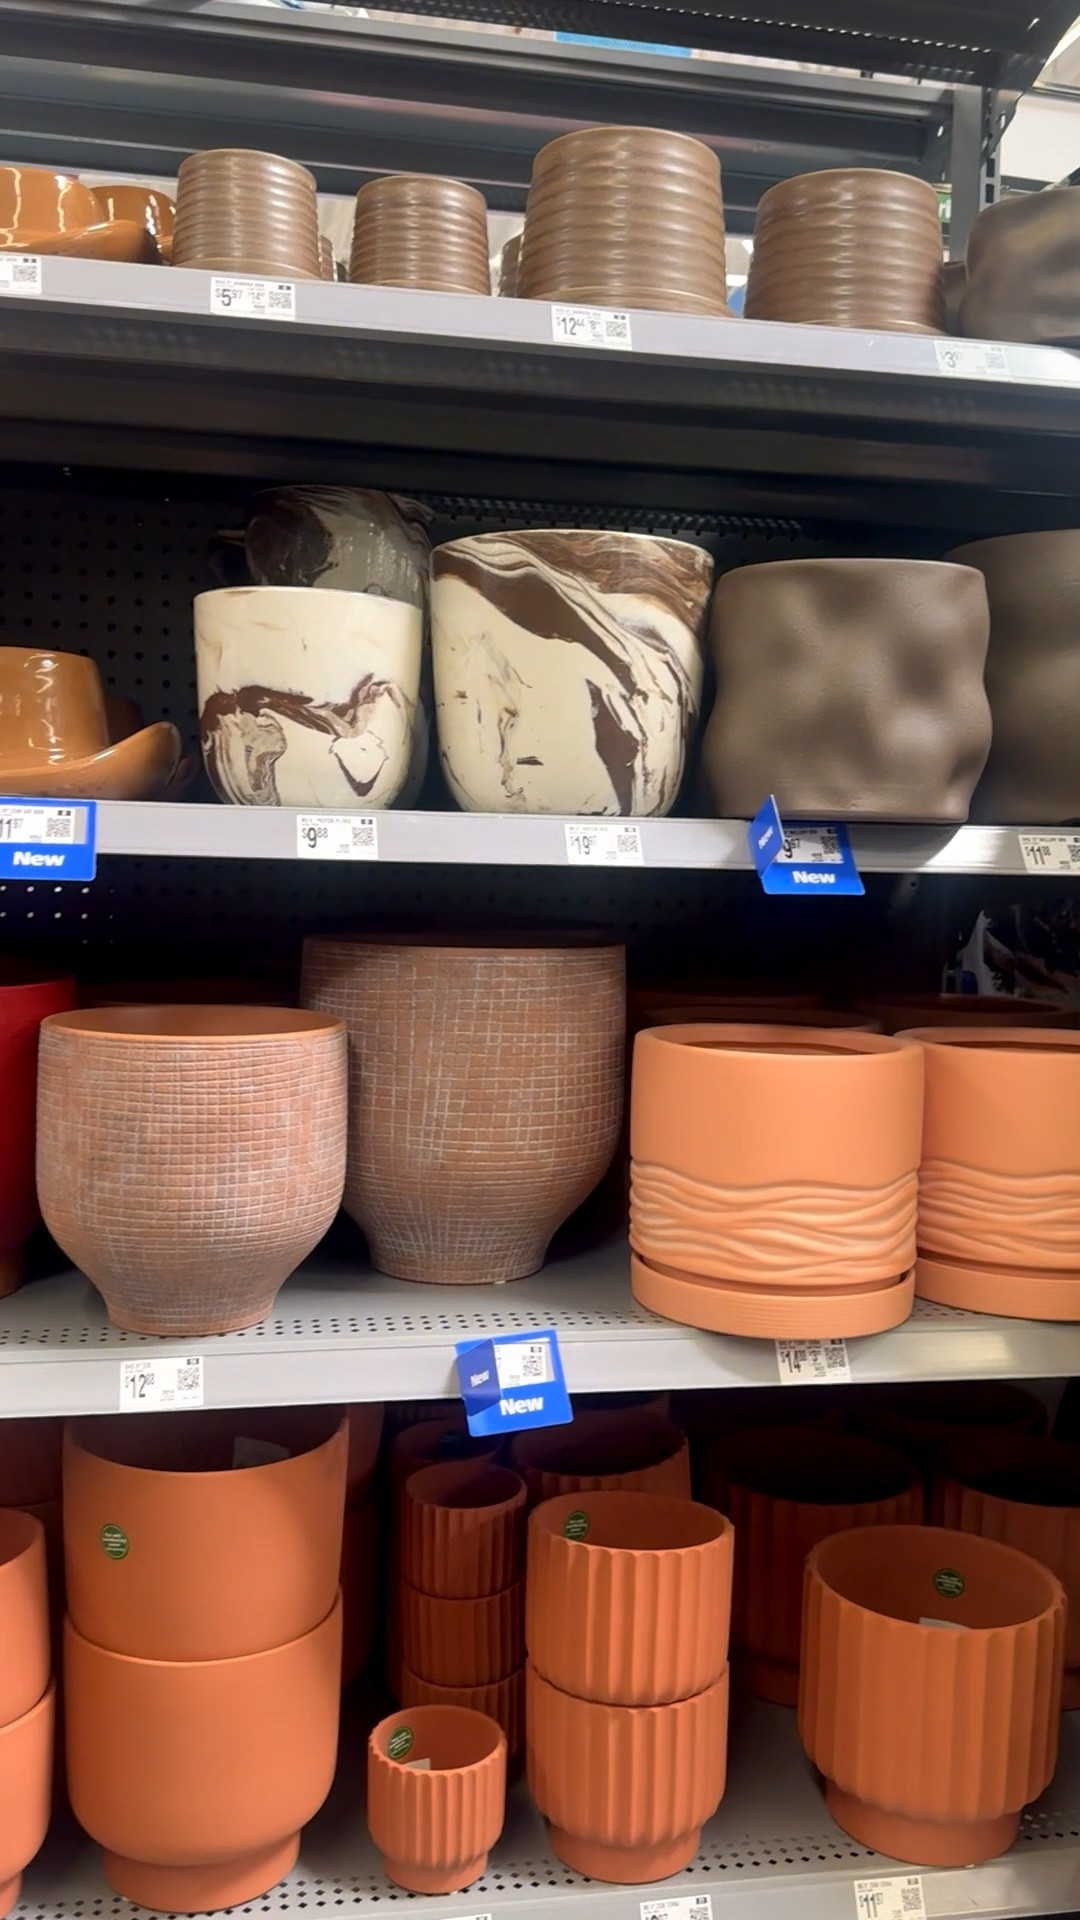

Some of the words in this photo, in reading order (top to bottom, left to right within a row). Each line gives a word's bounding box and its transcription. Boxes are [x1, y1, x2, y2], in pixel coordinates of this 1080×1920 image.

[302, 827, 328, 848] $988
[12, 851, 65, 867] New
[792, 870, 836, 884] New
[470, 1370, 490, 1388] New
[499, 1397, 544, 1416] New
